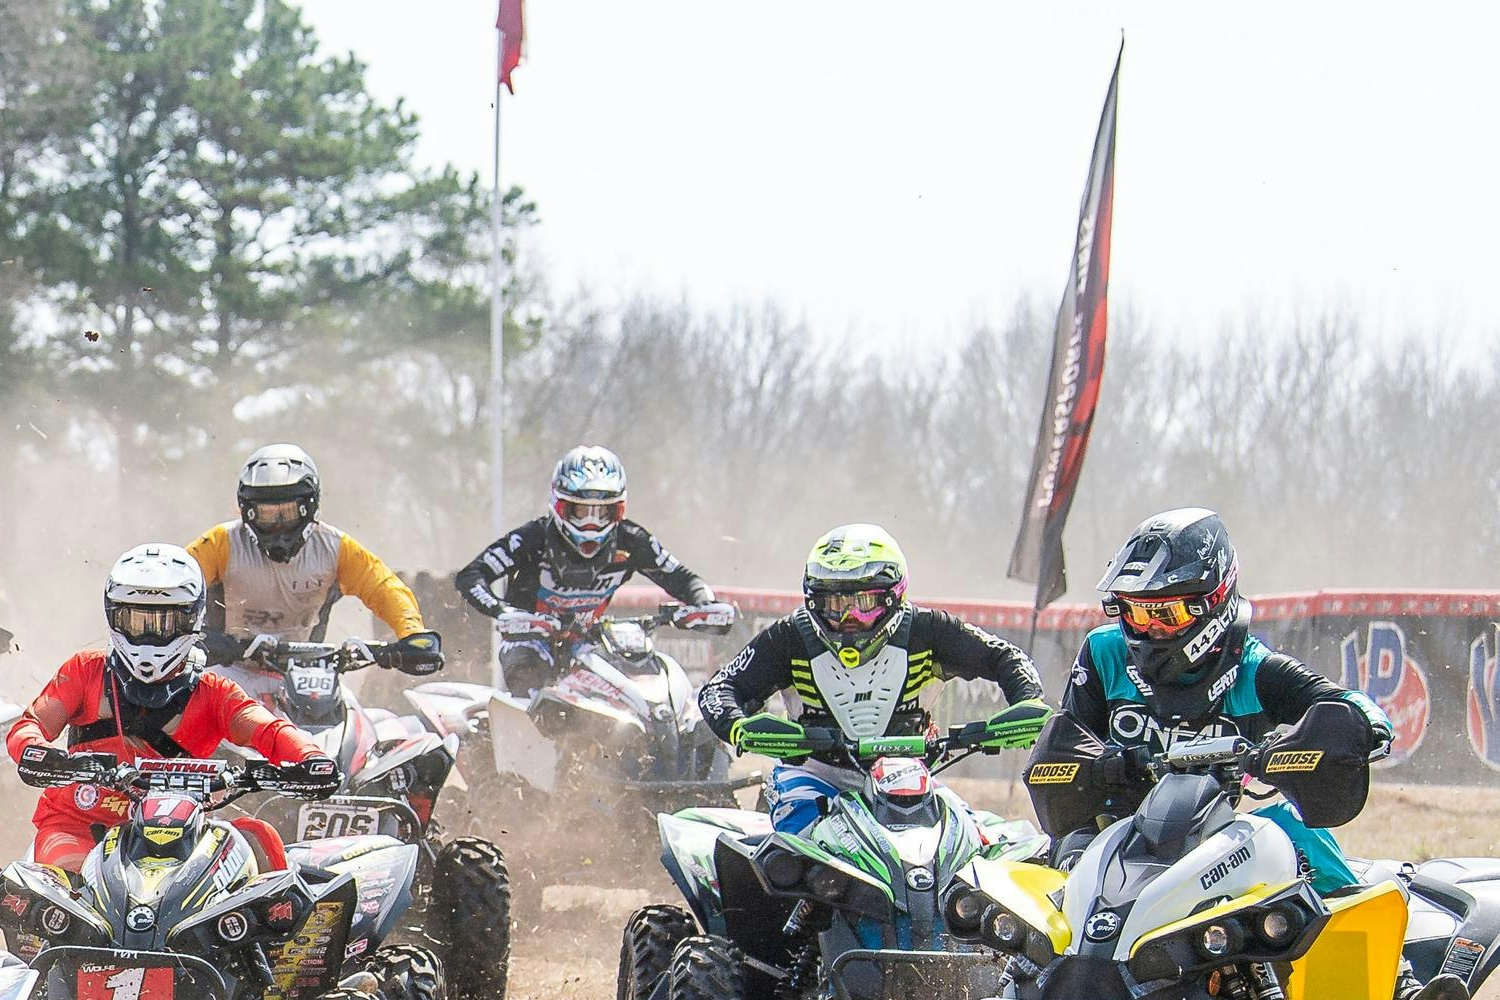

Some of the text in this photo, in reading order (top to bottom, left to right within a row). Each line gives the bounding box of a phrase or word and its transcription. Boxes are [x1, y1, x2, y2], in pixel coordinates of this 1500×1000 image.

[1189, 622, 1220, 658] 442
[296, 675, 333, 692] 206
[1126, 664, 1155, 698] LEATT
[1207, 664, 1241, 702] LEATT
[138, 761, 219, 774] RENTHAL
[1269, 751, 1319, 766] MOOSE
[1032, 764, 1077, 778] MOOSE
[153, 797, 177, 818] 1
[145, 828, 181, 838] can-am
[1199, 845, 1252, 891] can-am
